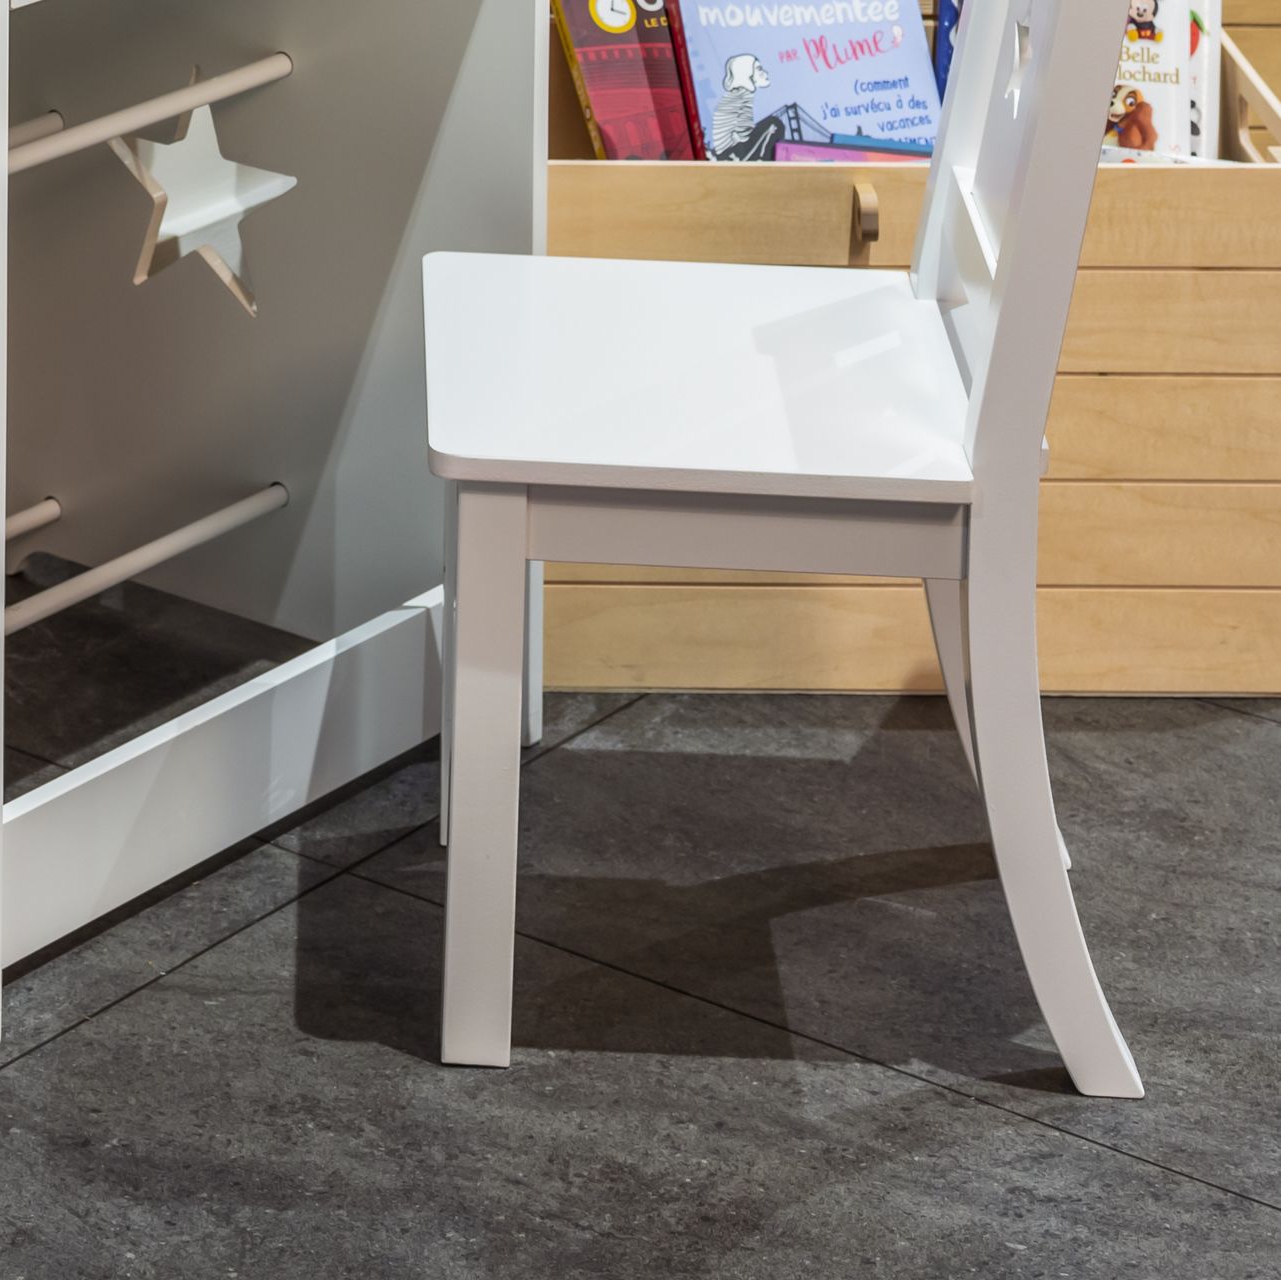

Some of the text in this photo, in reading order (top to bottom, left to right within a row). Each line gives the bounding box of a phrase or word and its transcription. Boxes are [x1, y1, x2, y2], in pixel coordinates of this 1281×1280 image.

[778, 49, 799, 64] PAR
[1120, 46, 1161, 65] Belle
[1117, 66, 1181, 85] lochard
[853, 76, 910, 95] (comment
[821, 94, 929, 120] j'ai survécu à des
[877, 114, 933, 133] vacances
